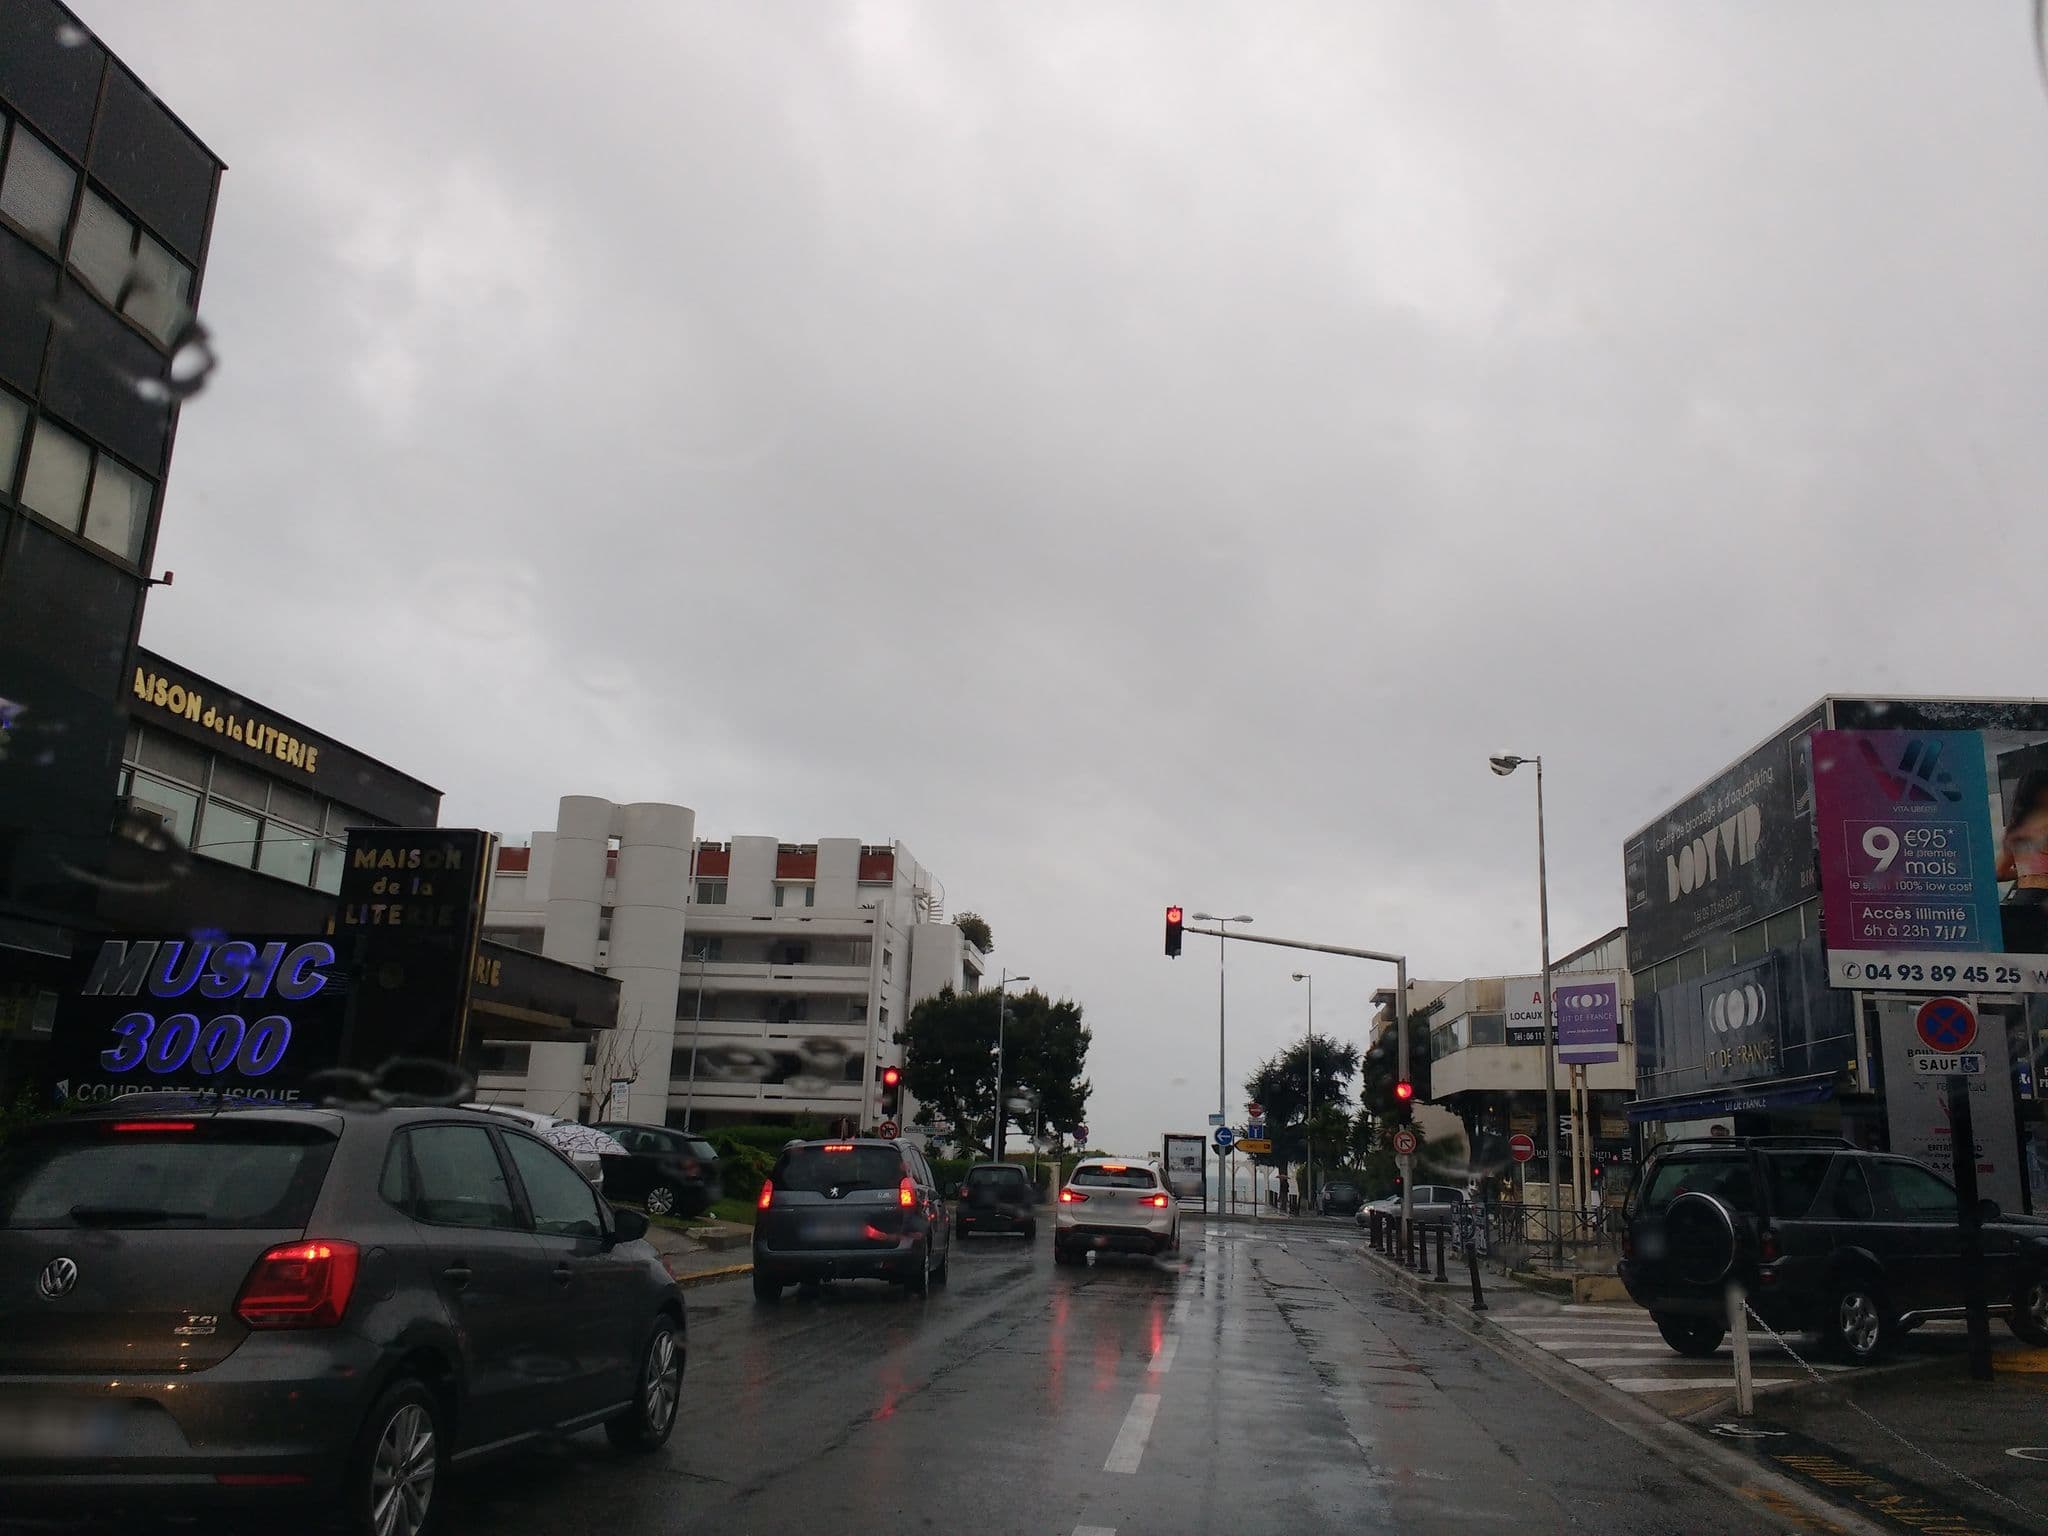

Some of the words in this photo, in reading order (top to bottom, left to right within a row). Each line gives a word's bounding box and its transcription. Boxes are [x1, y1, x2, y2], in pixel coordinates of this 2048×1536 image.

[133, 666, 202, 723] AISON
[202, 706, 224, 733] de
[227, 715, 243, 741] la
[245, 718, 320, 774] LITERIE
[352, 847, 463, 871] MAISON
[1862, 826, 1900, 874] 9
[1904, 848, 1914, 858] le
[1917, 849, 1957, 860] premier
[1904, 858, 1957, 876] mois
[371, 875, 401, 896] de
[411, 877, 433, 896] la
[1850, 879, 1860, 890] le
[1895, 880, 1923, 892] 100%
[1926, 880, 1946, 891] low
[1948, 881, 1973, 892] cost
[1862, 906, 1912, 921] Accès
[1916, 906, 1966, 921] illimité
[1863, 922, 1882, 937] 6h
[1887, 922, 1898, 937] à
[1902, 923, 1930, 938] 23h
[1934, 924, 1967, 939] 7j/7
[80, 940, 336, 1000] MUSIC
[1865, 963, 1892, 982] 04
[1897, 964, 1924, 982] 93
[1931, 965, 1957, 983] 89
[1963, 966, 1989, 983] 45
[1995, 967, 2022, 984] 25
[1532, 991, 1543, 1004] A
[1510, 1011, 1543, 1021] LOCAUX
[100, 1012, 293, 1077] 3000
[1736, 1036, 1776, 1065] FRANCE
[1919, 1059, 1958, 1071] SAUF
